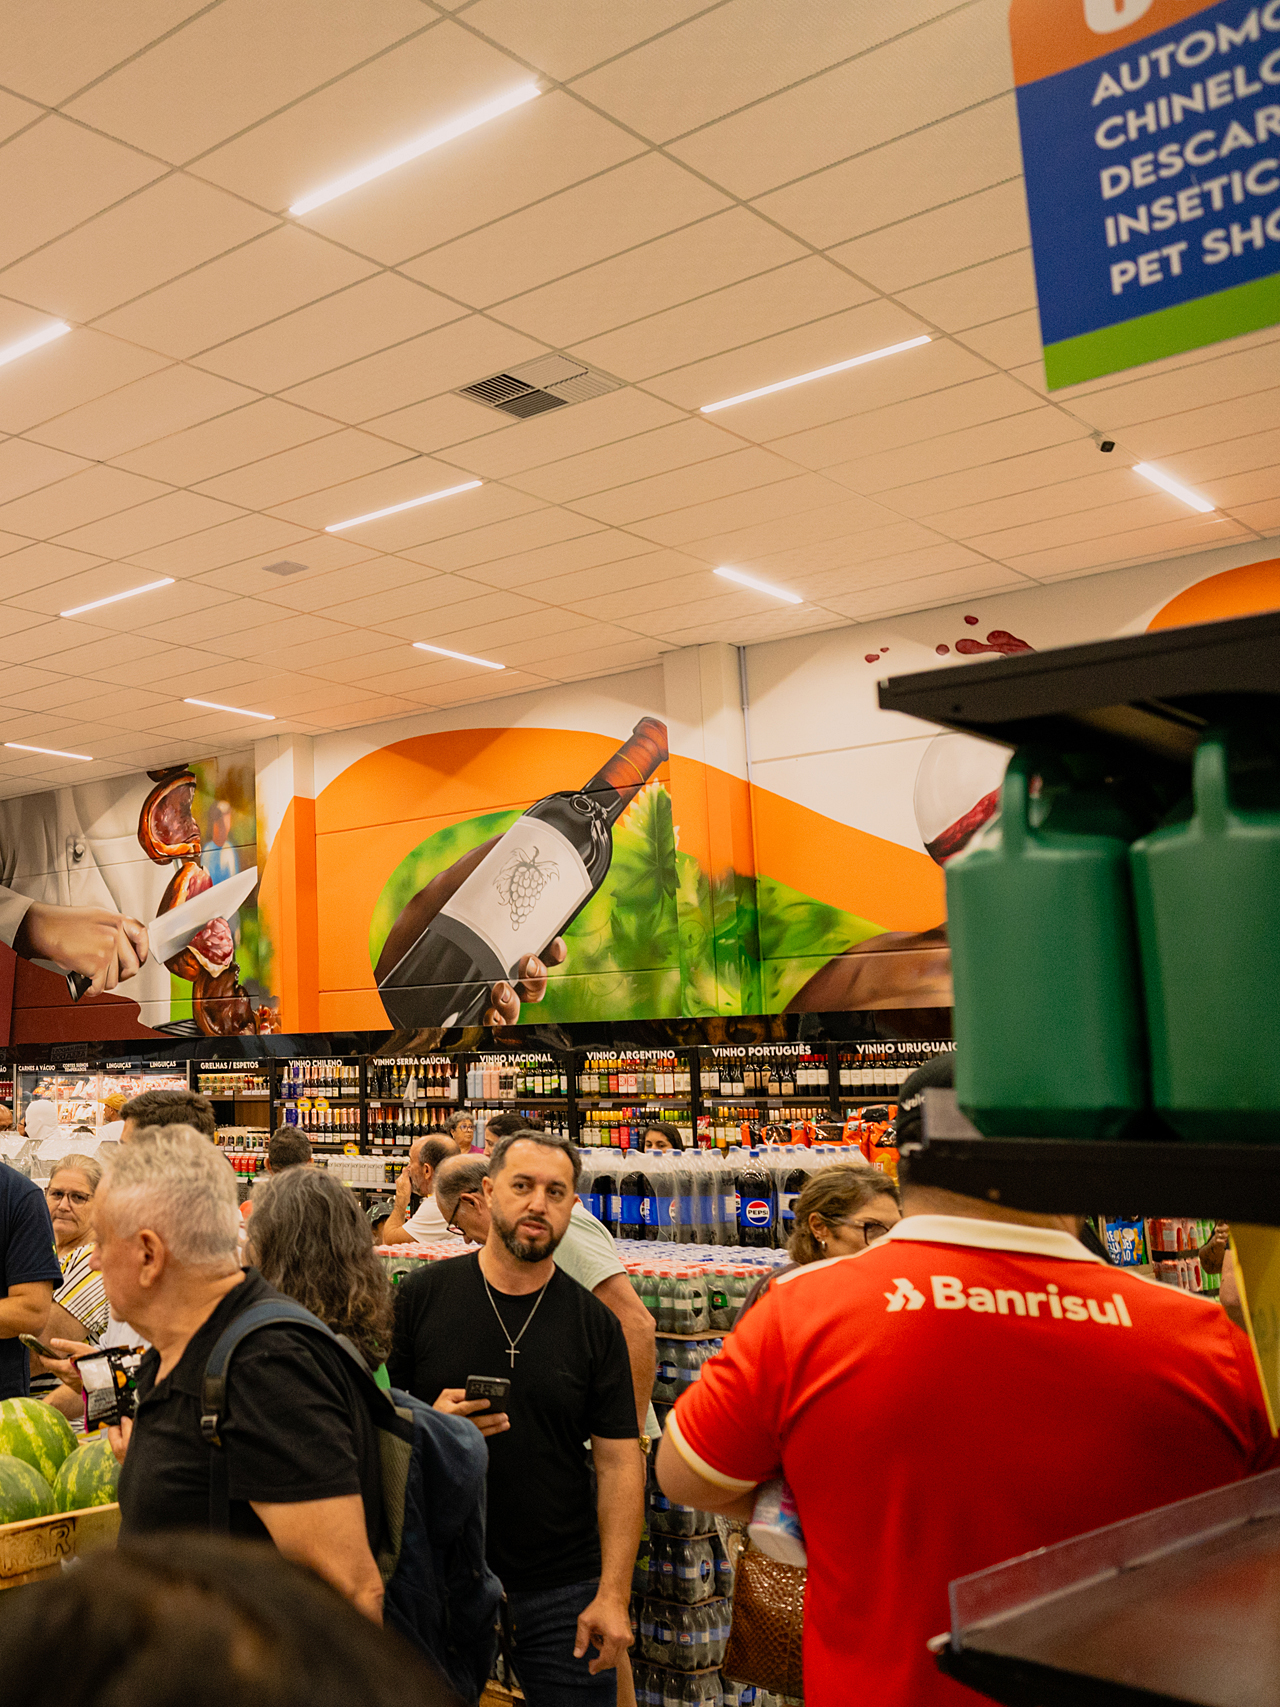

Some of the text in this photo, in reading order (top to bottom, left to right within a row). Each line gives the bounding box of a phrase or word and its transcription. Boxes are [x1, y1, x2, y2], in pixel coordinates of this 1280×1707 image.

[1100, 104, 1280, 199] DESCAR
[1104, 157, 1280, 247] INSETIC
[1110, 242, 1188, 295] PET
[711, 1043, 812, 1058] VINHO PORTUGUÊS
[855, 1043, 895, 1054] VINHO
[479, 1053, 553, 1063] VINHO NACIONAL
[586, 1049, 676, 1060] VINHO ARGENTINO
[149, 1060, 177, 1068] LINGUIÇAS
[200, 1061, 227, 1070] GRELHAS
[232, 1061, 259, 1069] ESPETOS
[288, 1058, 343, 1068] VINHO CHILENO
[372, 1055, 452, 1066] VINHO SERRA GAÚCHA
[39, 1063, 56, 1071] VÁCUO
[930, 1275, 1133, 1327] Banrisul
